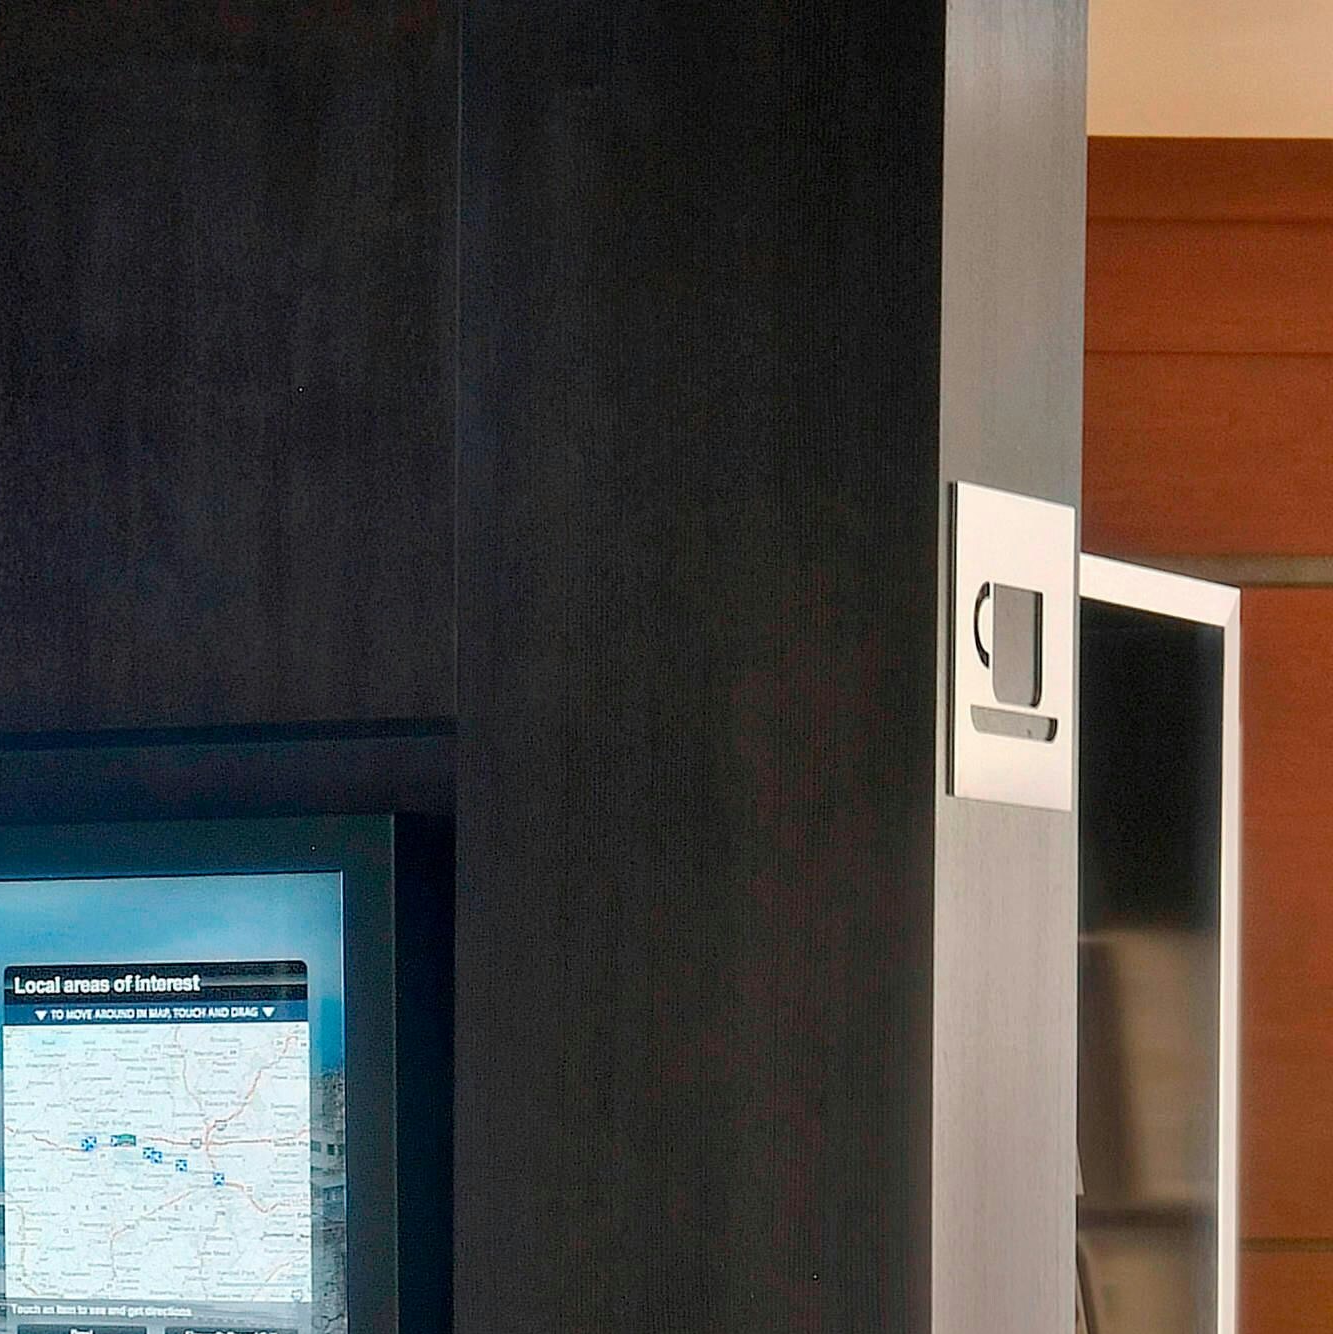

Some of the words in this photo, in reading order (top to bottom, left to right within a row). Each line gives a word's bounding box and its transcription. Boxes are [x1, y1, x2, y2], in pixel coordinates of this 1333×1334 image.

[14, 976, 61, 994] Local
[63, 977, 110, 993] areas
[113, 975, 133, 992] of
[134, 974, 201, 992] interest
[50, 1009, 65, 1019] TO
[173, 1007, 207, 1018] TOUCH
